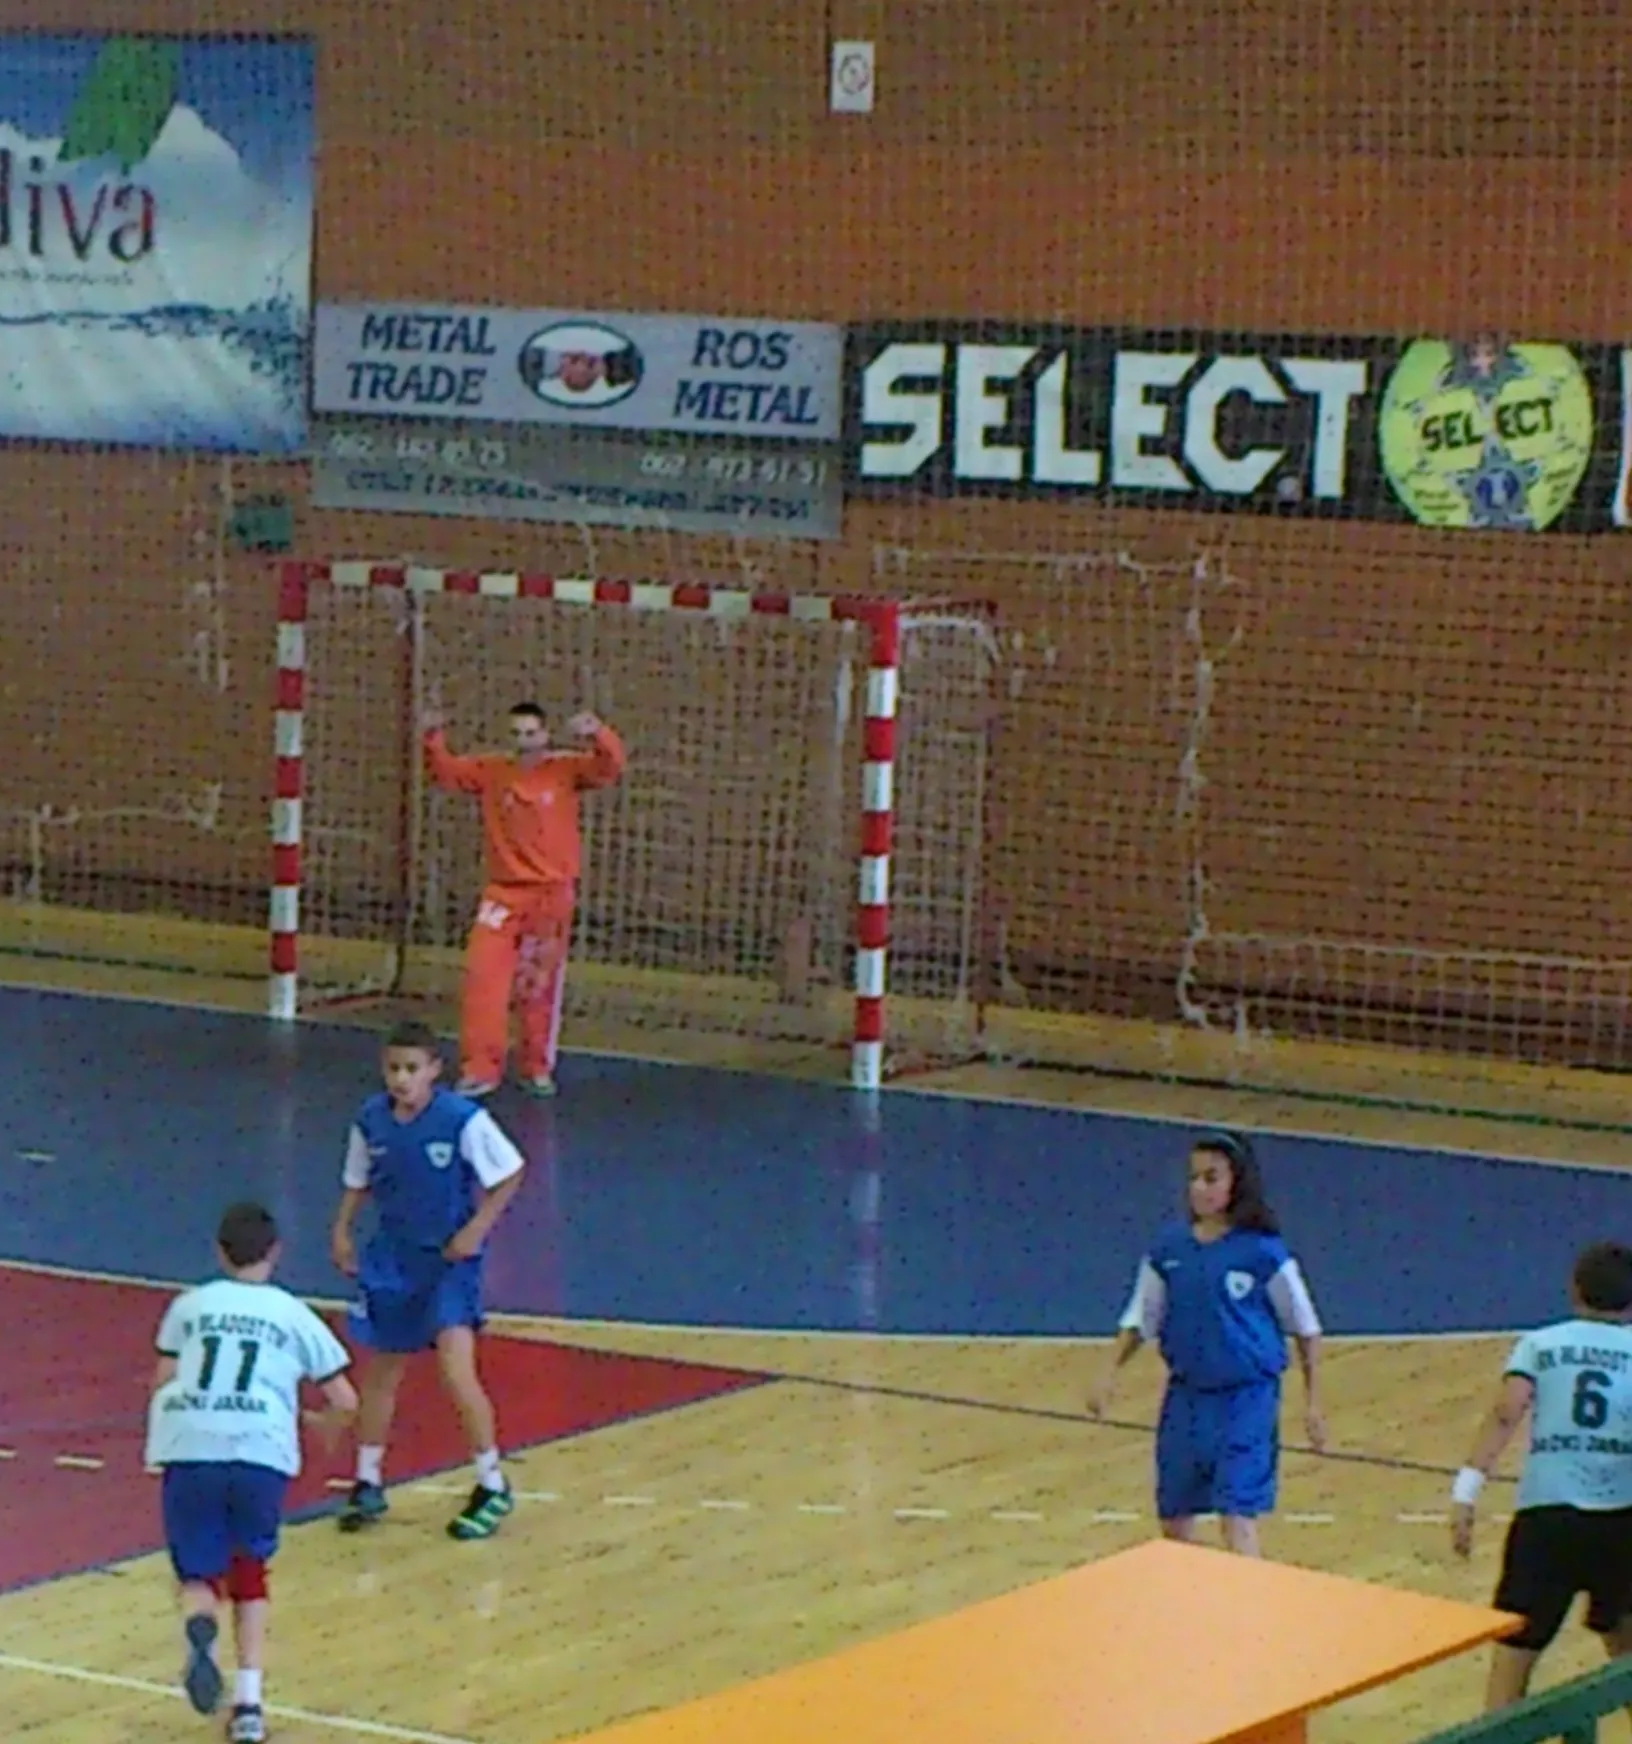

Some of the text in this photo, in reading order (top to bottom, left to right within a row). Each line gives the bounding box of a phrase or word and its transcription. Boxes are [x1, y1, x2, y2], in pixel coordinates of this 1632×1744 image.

[361, 313, 496, 356] METAL
[691, 328, 793, 369] ROS
[345, 361, 487, 405] TRADE
[672, 379, 820, 426] METAL
[860, 341, 1369, 500] SELECT
[1421, 397, 1554, 452] SELECT
[198, 1335, 260, 1392] 11
[1572, 1368, 1613, 1430] 6
